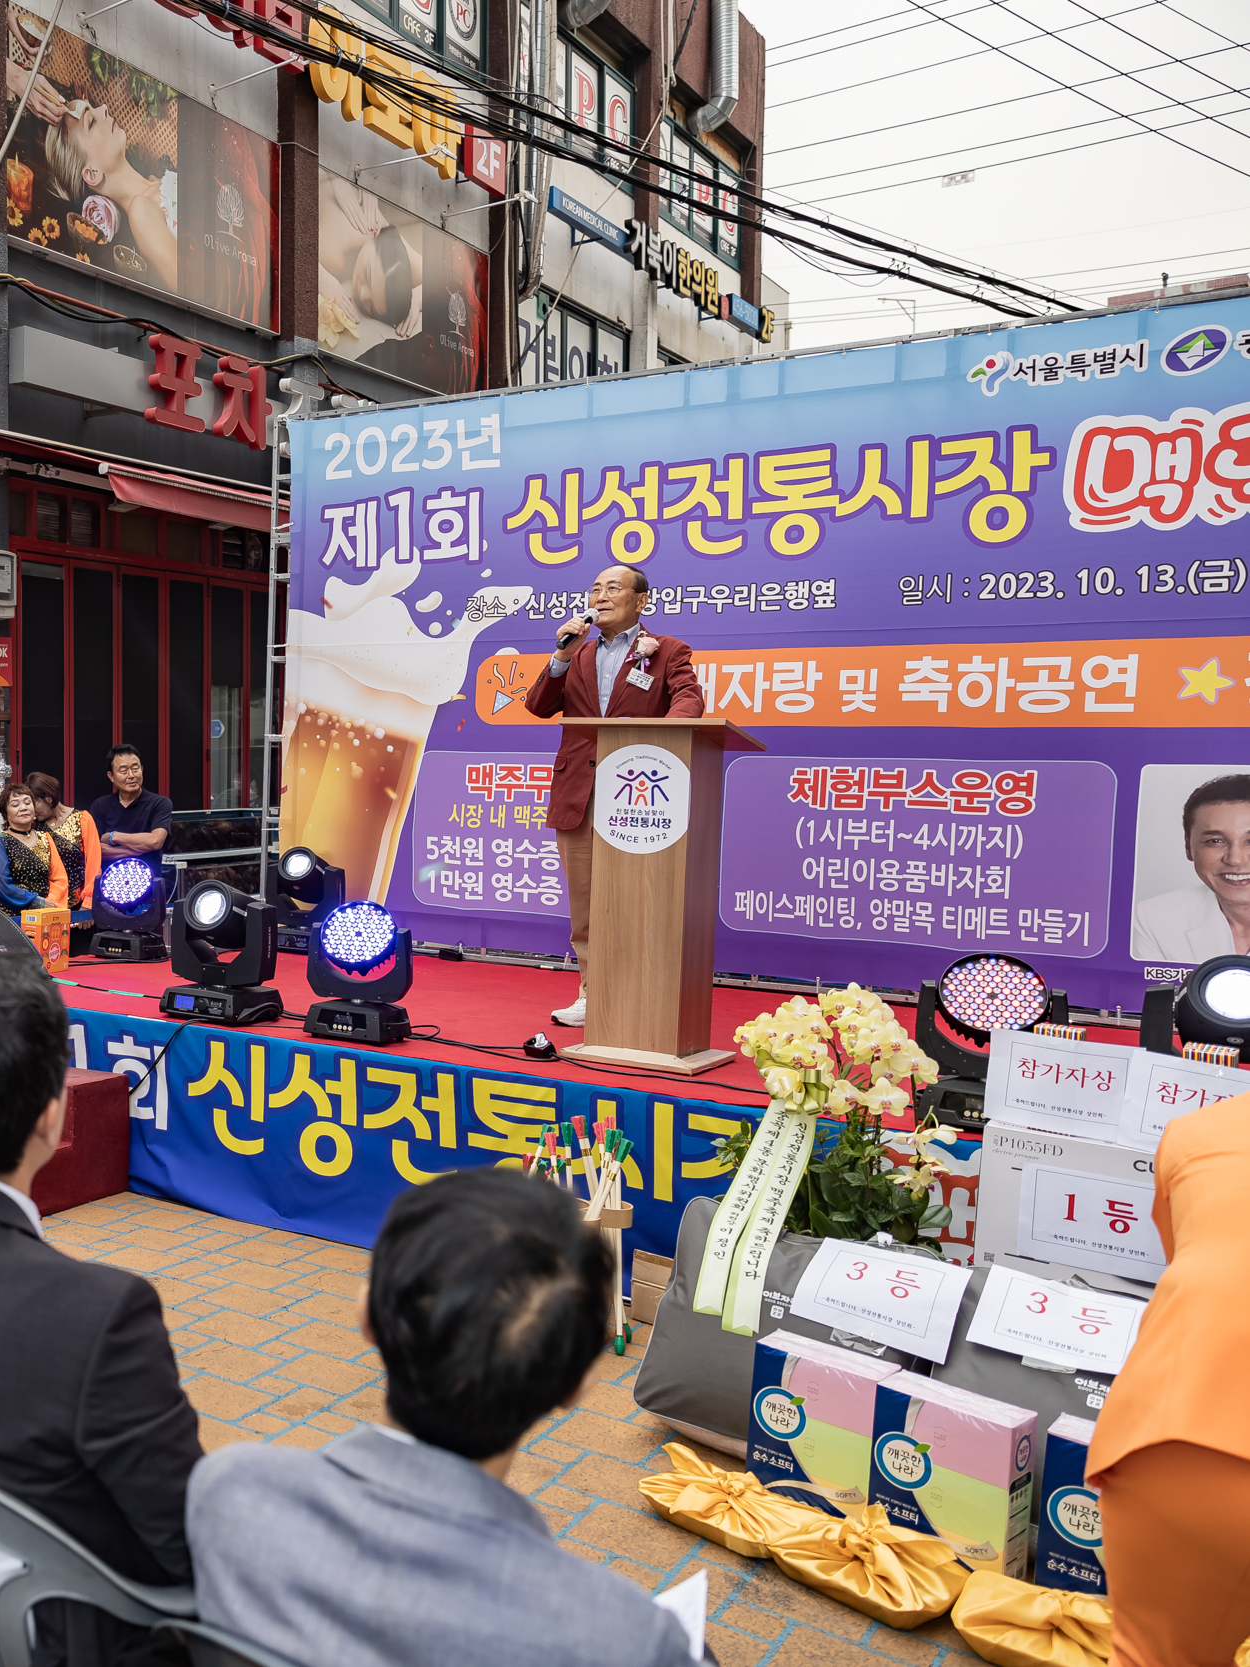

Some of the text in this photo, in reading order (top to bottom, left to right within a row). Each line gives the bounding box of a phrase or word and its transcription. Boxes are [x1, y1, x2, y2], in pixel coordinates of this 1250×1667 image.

[403, 14, 435, 46] CAFE 3F
[476, 137, 503, 179] 2F
[562, 196, 619, 241] KOREAN MEDICAL CLINIC
[204, 233, 257, 267] Olive Aroma
[761, 307, 775, 342] 2F
[439, 334, 475, 358] Olive Aroma
[1013, 343, 1145, 383] 서울특별시
[144, 332, 273, 451] 포차
[323, 412, 502, 482] 2023년
[319, 486, 484, 570] 제1회
[503, 427, 1053, 567] 신성전통시장
[899, 572, 953, 606] 일시
[977, 570, 1065, 603] 2023.
[1075, 566, 1125, 598] 10.
[1136, 558, 1248, 596] 13.(금)
[466, 596, 507, 623] 장소
[838, 668, 878, 713] 및
[898, 653, 1139, 715] 축하공연
[787, 766, 1038, 817] 체험부스운영
[448, 804, 483, 828] 시장
[490, 805, 506, 828] 내
[608, 816, 672, 829] 신성전통시장
[426, 836, 561, 871] 5천원 영수증
[609, 829, 668, 843] SINCE 1972
[795, 816, 1024, 859] (1시부터~4시까지)
[427, 870, 563, 906] 1만원 영수증
[802, 856, 1011, 899] 어린이용품바자회
[734, 890, 1090, 947] 페이스페인팅, 양말목 티메트 만들기
[1017, 1058, 1117, 1092] 참가자상
[999, 1136, 1064, 1157] P1055FD
[1062, 1193, 1139, 1234] 1 등
[846, 1261, 921, 1299] 3 등
[1026, 1292, 1112, 1335] 3 등
[765, 1400, 797, 1419] 깨끗한
[770, 1414, 790, 1428] 나라
[753, 1451, 794, 1473] 순수소프티
[887, 1447, 921, 1467] 깨끗한
[893, 1462, 914, 1477] 나라
[1069, 1517, 1094, 1535] 나라
[965, 1546, 988, 1554] SOFTY
[1047, 1559, 1100, 1586] 순수소프티
